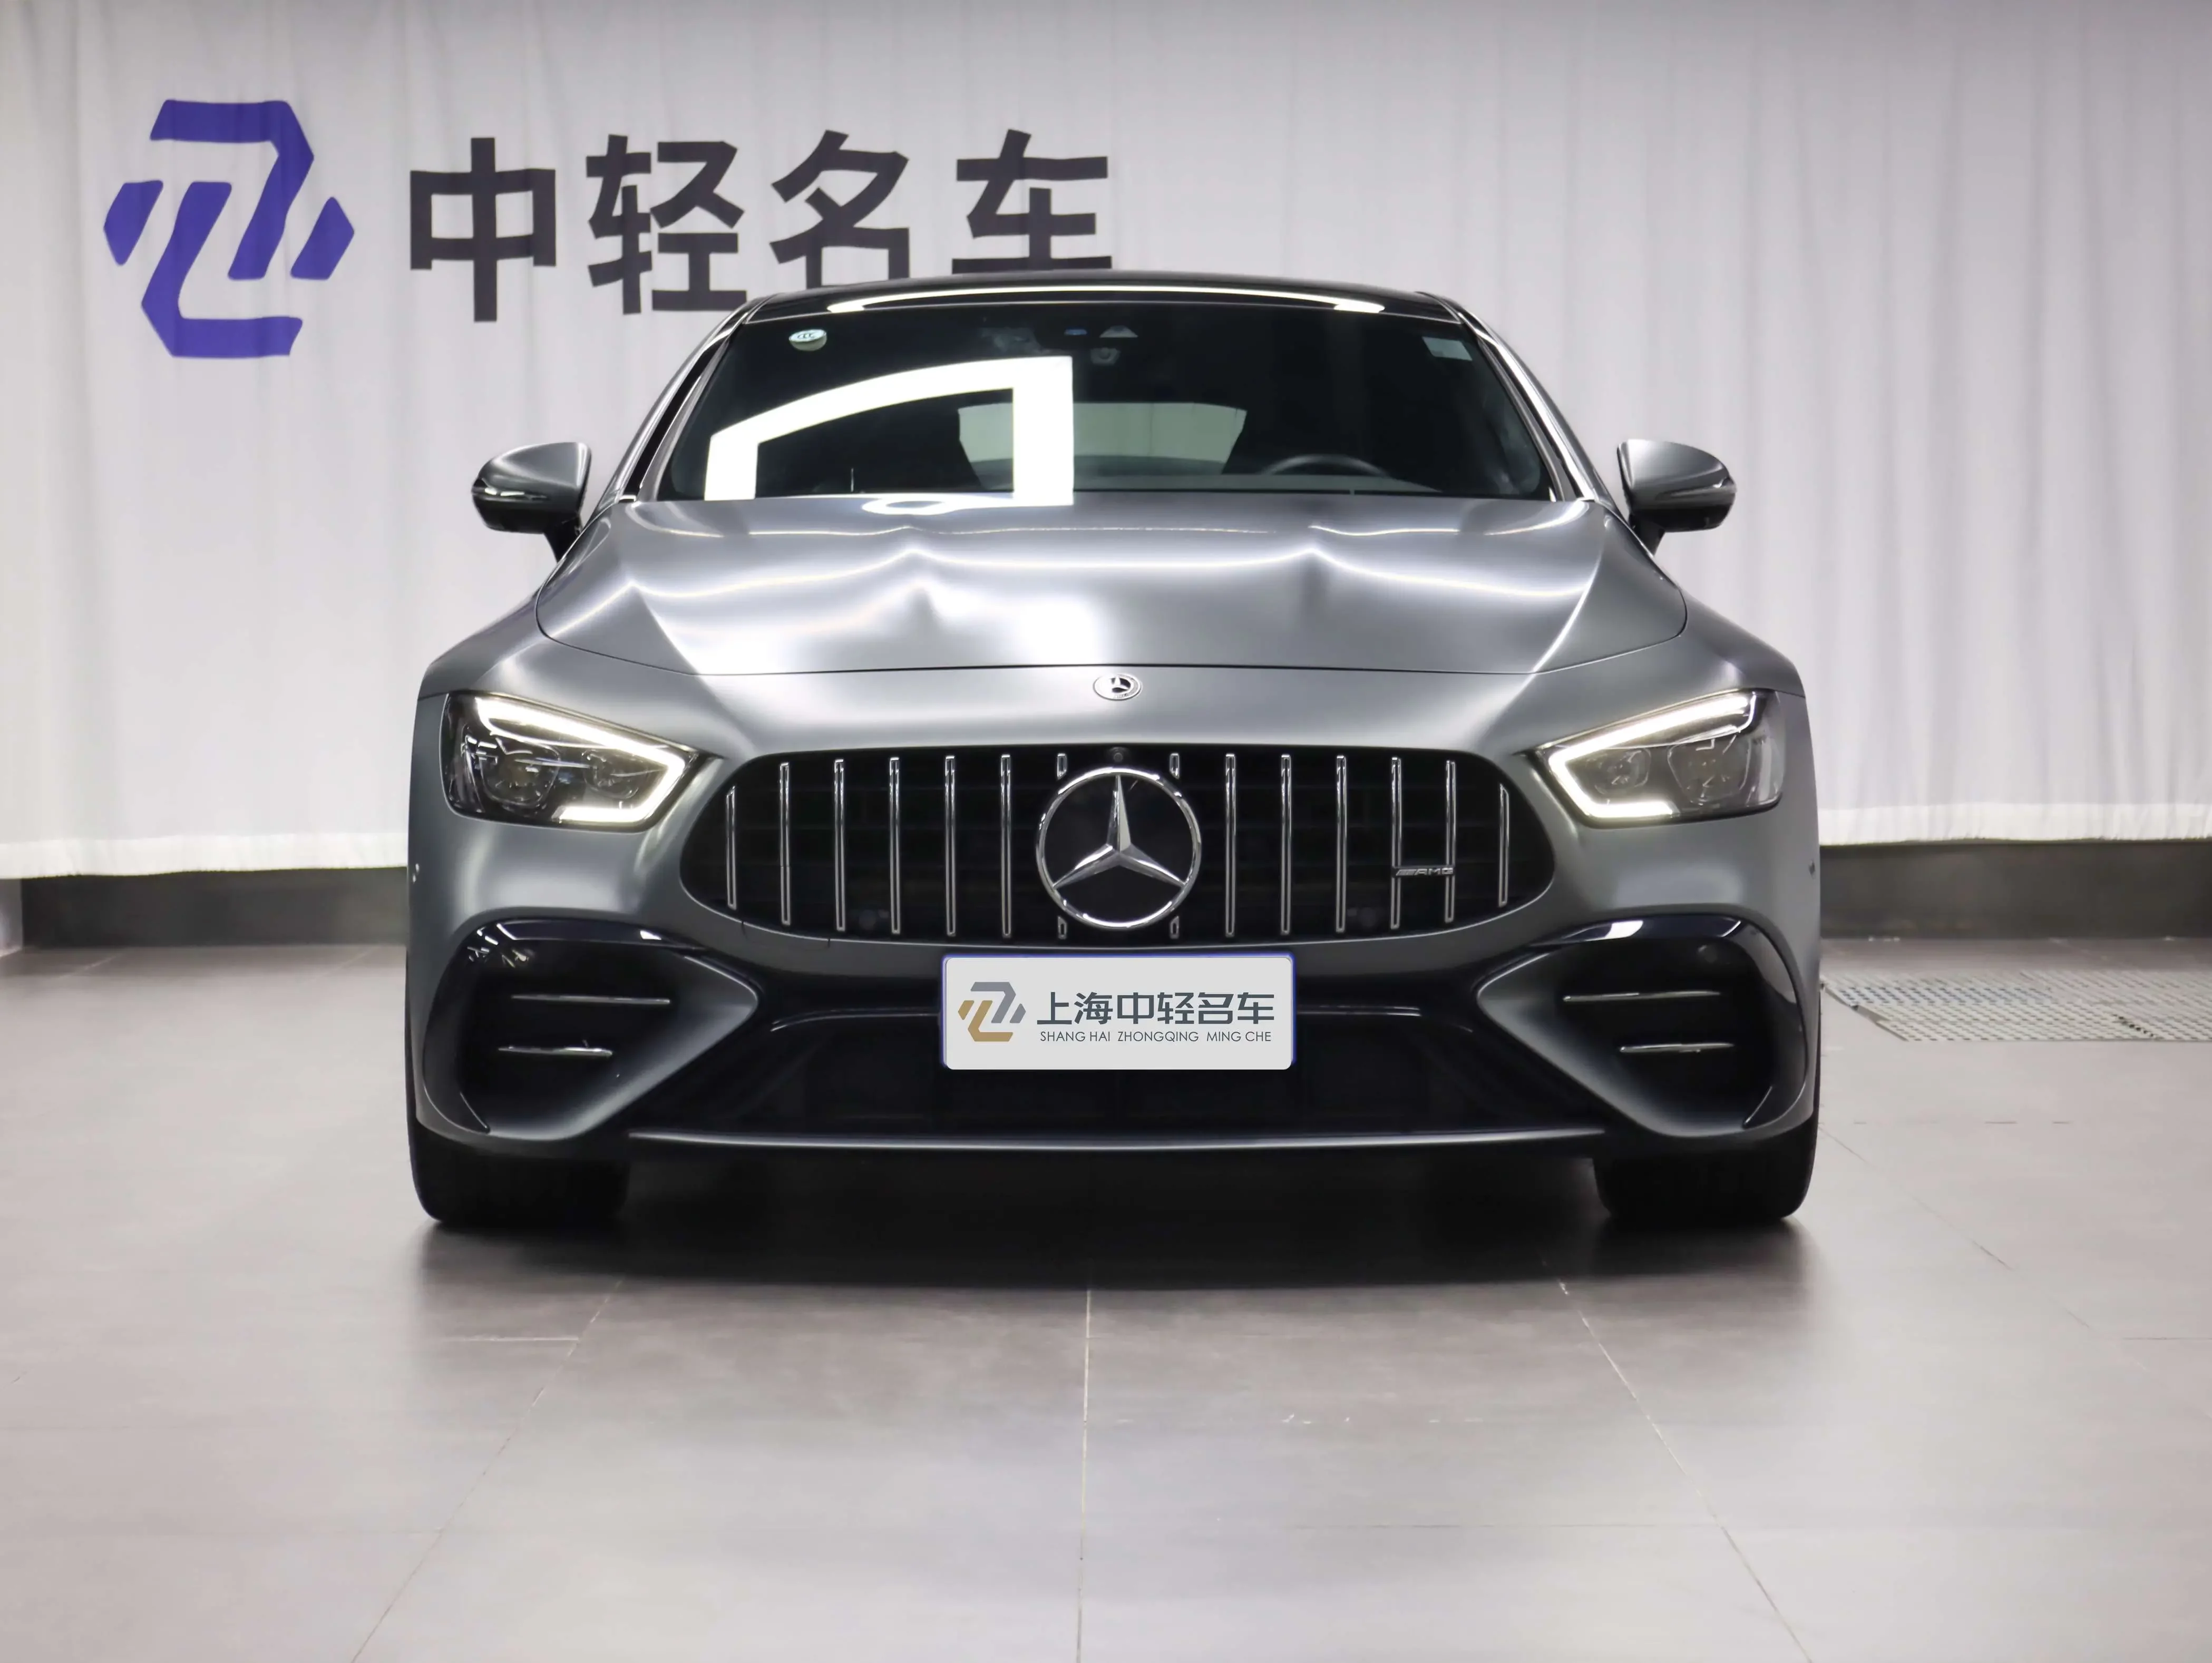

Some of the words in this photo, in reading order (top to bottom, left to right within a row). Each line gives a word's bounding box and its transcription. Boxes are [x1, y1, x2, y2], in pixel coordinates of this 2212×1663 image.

[410, 129, 1112, 322] 中轻名车
[1414, 867, 1454, 876] AMG
[1037, 992, 1274, 1025] 上海中轻名车
[1040, 1031, 1086, 1042] SHANG
[1090, 1031, 1110, 1042] HAI
[1117, 1031, 1199, 1043] ZHONGQING
[1206, 1031, 1241, 1042] MING
[1245, 1031, 1271, 1042] CHE
